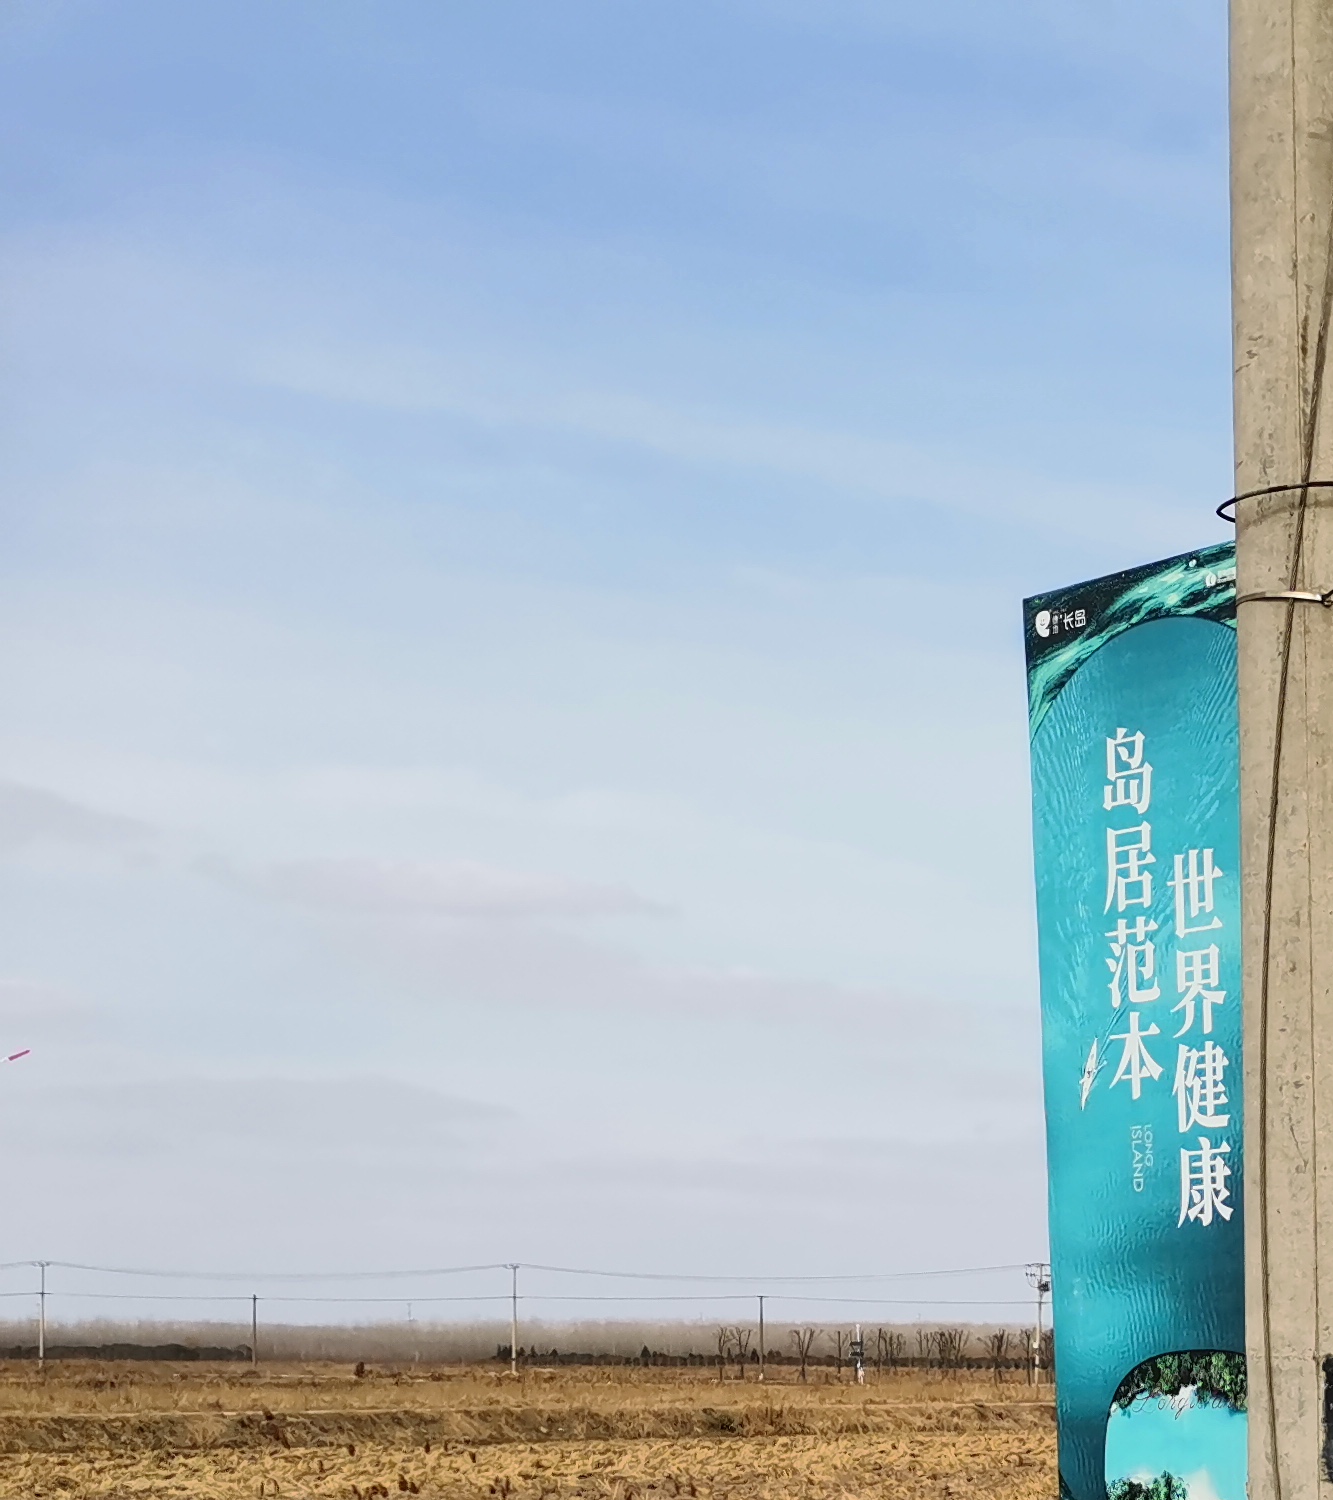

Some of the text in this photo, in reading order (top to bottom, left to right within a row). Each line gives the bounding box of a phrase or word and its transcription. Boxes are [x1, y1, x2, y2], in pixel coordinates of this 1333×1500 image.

[1102, 727, 1164, 1100] 岛居范本
[1143, 1124, 1154, 1167] LONG
[1167, 848, 1234, 1228] 世界健康
[1130, 1125, 1144, 1193] ISLAND
